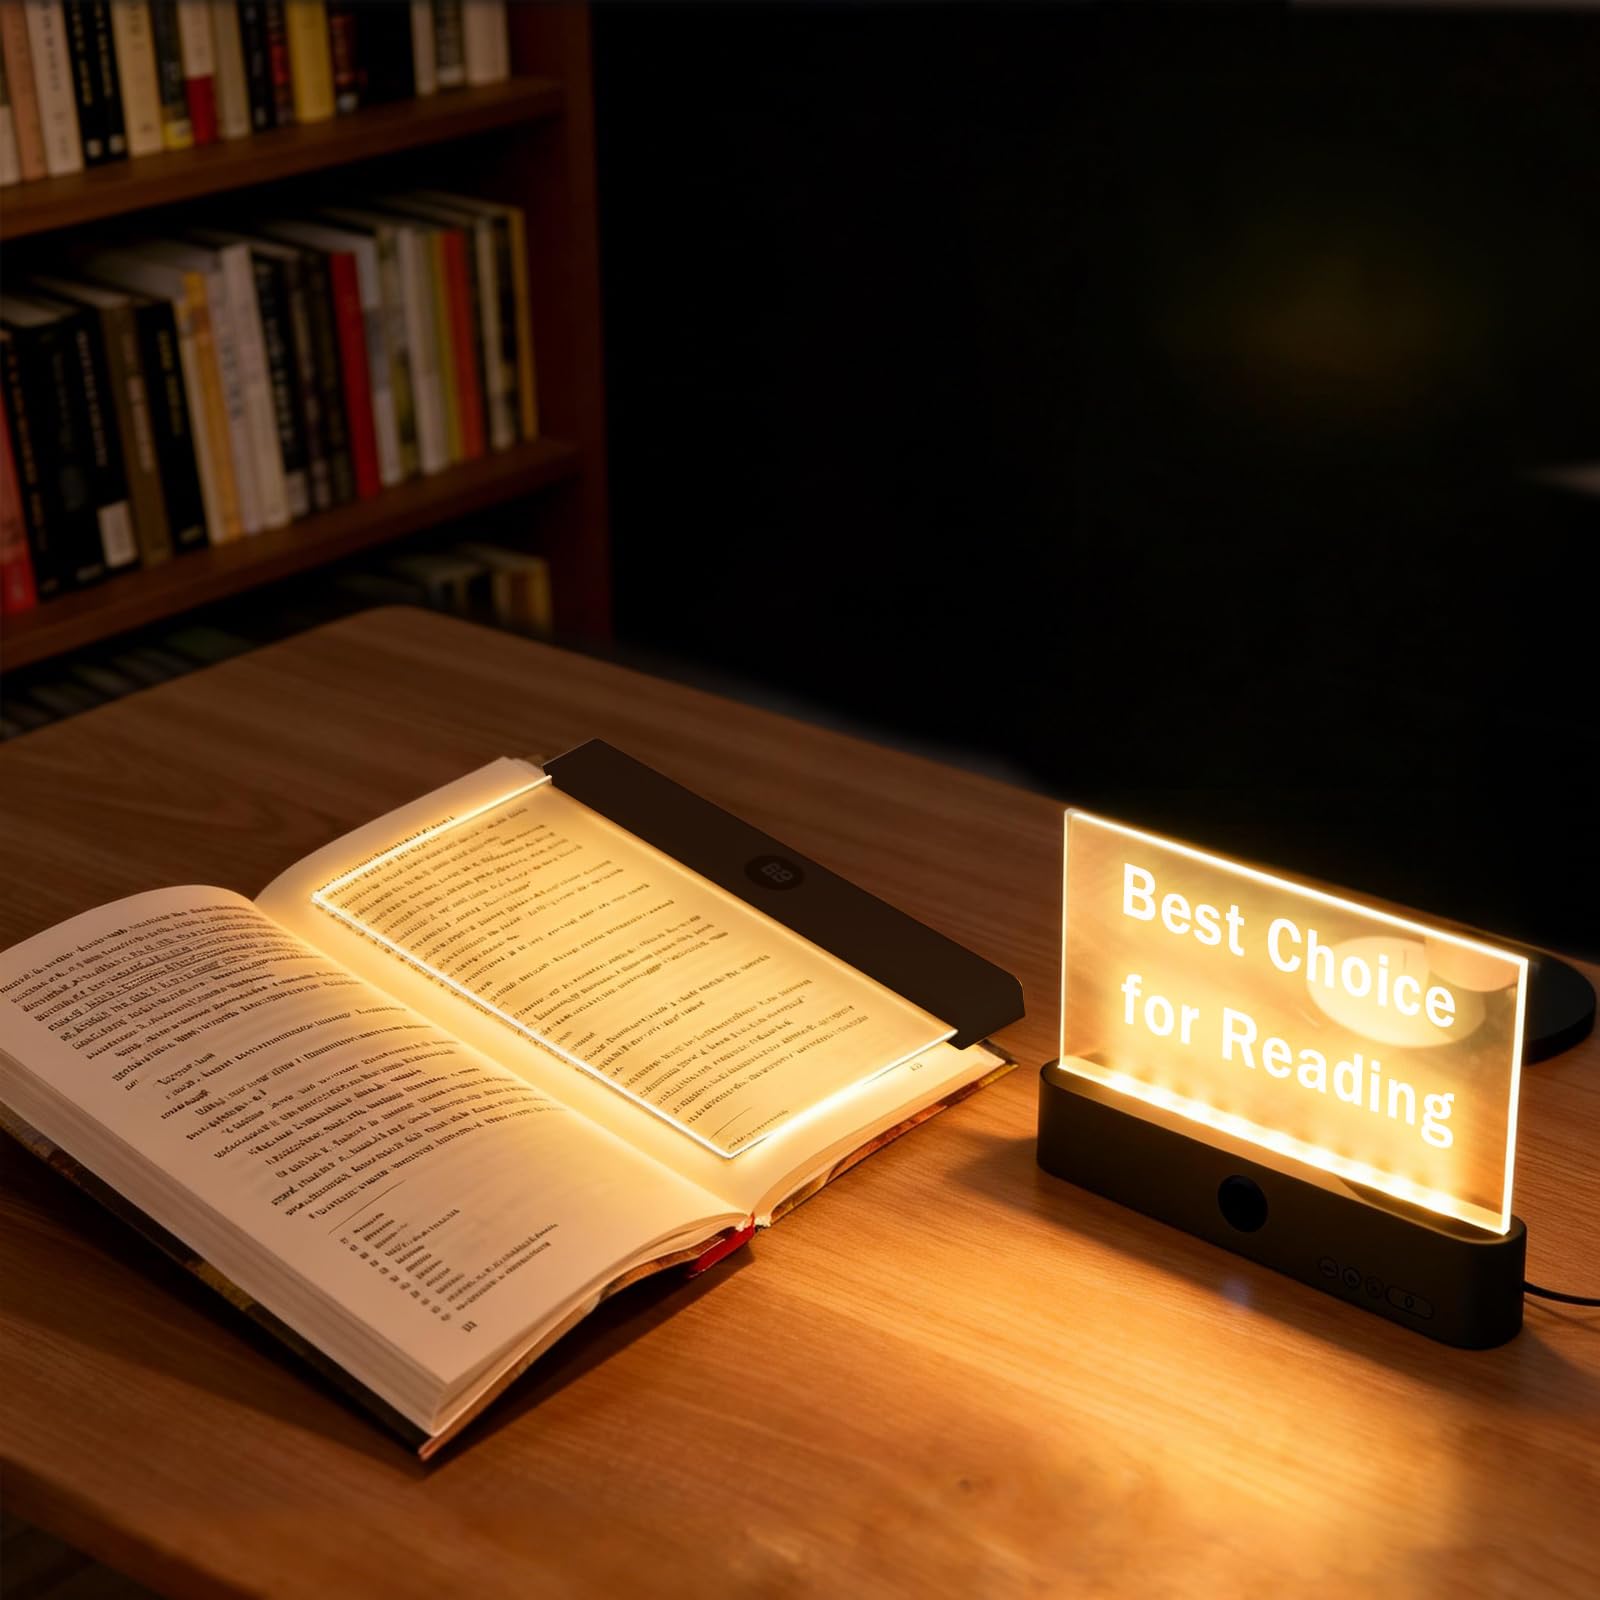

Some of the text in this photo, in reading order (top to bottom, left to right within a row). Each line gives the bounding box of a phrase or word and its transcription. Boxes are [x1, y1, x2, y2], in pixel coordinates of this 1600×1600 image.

[1122, 863, 1456, 1028] Best Choice
[1120, 974, 1455, 1148] for Reading
